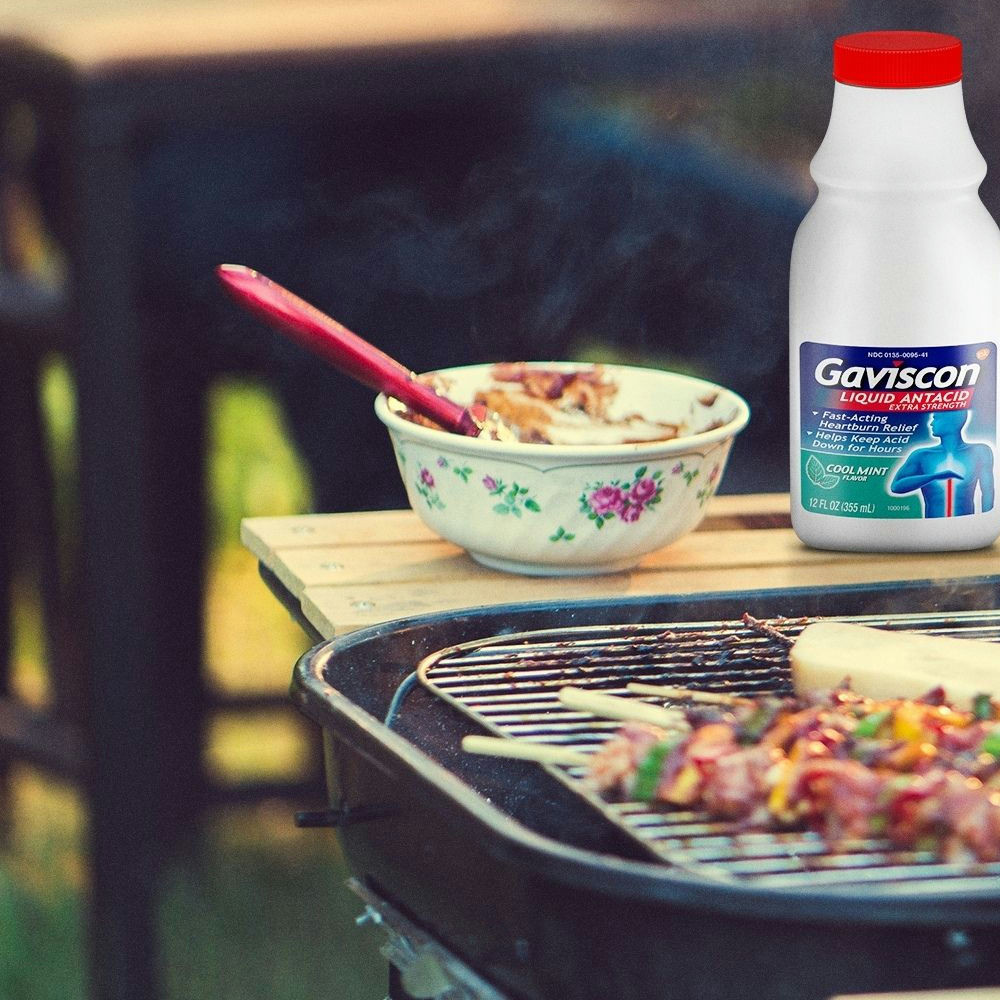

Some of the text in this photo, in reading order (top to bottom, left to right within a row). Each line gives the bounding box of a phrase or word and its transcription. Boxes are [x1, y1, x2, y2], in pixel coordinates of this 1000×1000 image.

[814, 357, 981, 390] Gaviscon
[840, 390, 970, 405] LIQUID ANTACID
[888, 401, 967, 411] EXTRA STRENGTH
[822, 411, 888, 424] Fast-Acting
[819, 420, 919, 432] Heartburn Relief
[815, 431, 910, 444] Helps Keep Acid
[812, 440, 844, 450] Down
[868, 444, 902, 453] Hours
[826, 464, 888, 476] COOL MINT
[809, 498, 875, 513] 12 FL OZ (355 mL)
